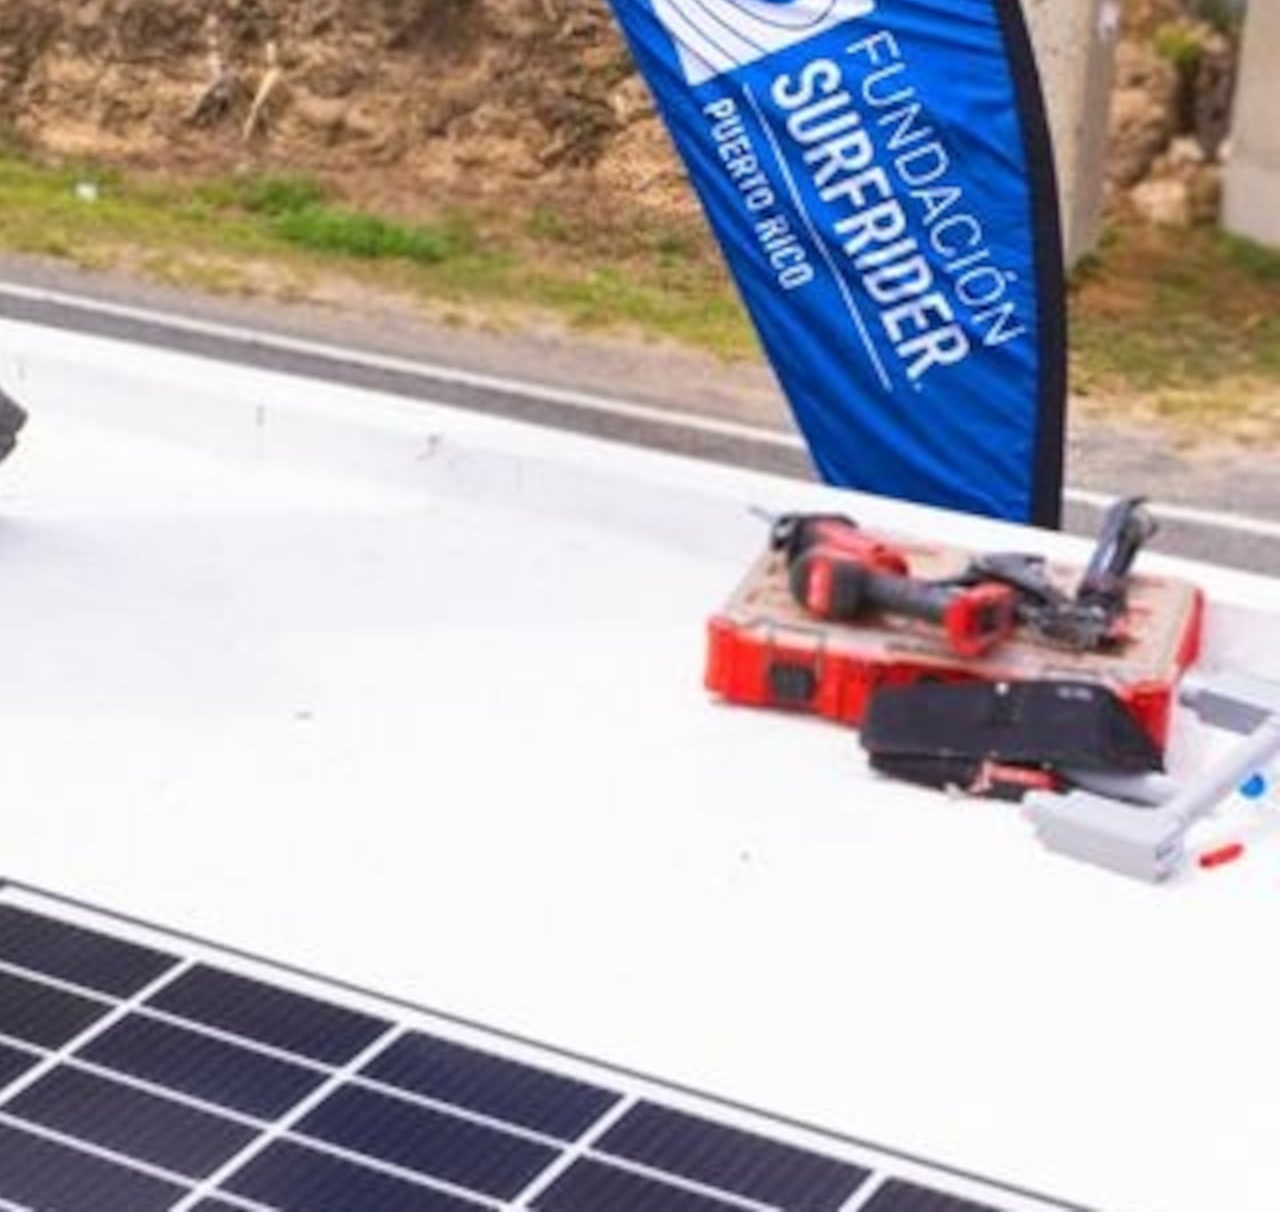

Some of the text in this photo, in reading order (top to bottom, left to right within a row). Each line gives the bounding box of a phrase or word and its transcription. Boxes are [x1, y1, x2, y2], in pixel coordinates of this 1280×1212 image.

[703, 97, 814, 290] PUERTO RICO
[771, 58, 970, 382] SURFRIDER
[846, 30, 1024, 347] FUNDACIÓN
